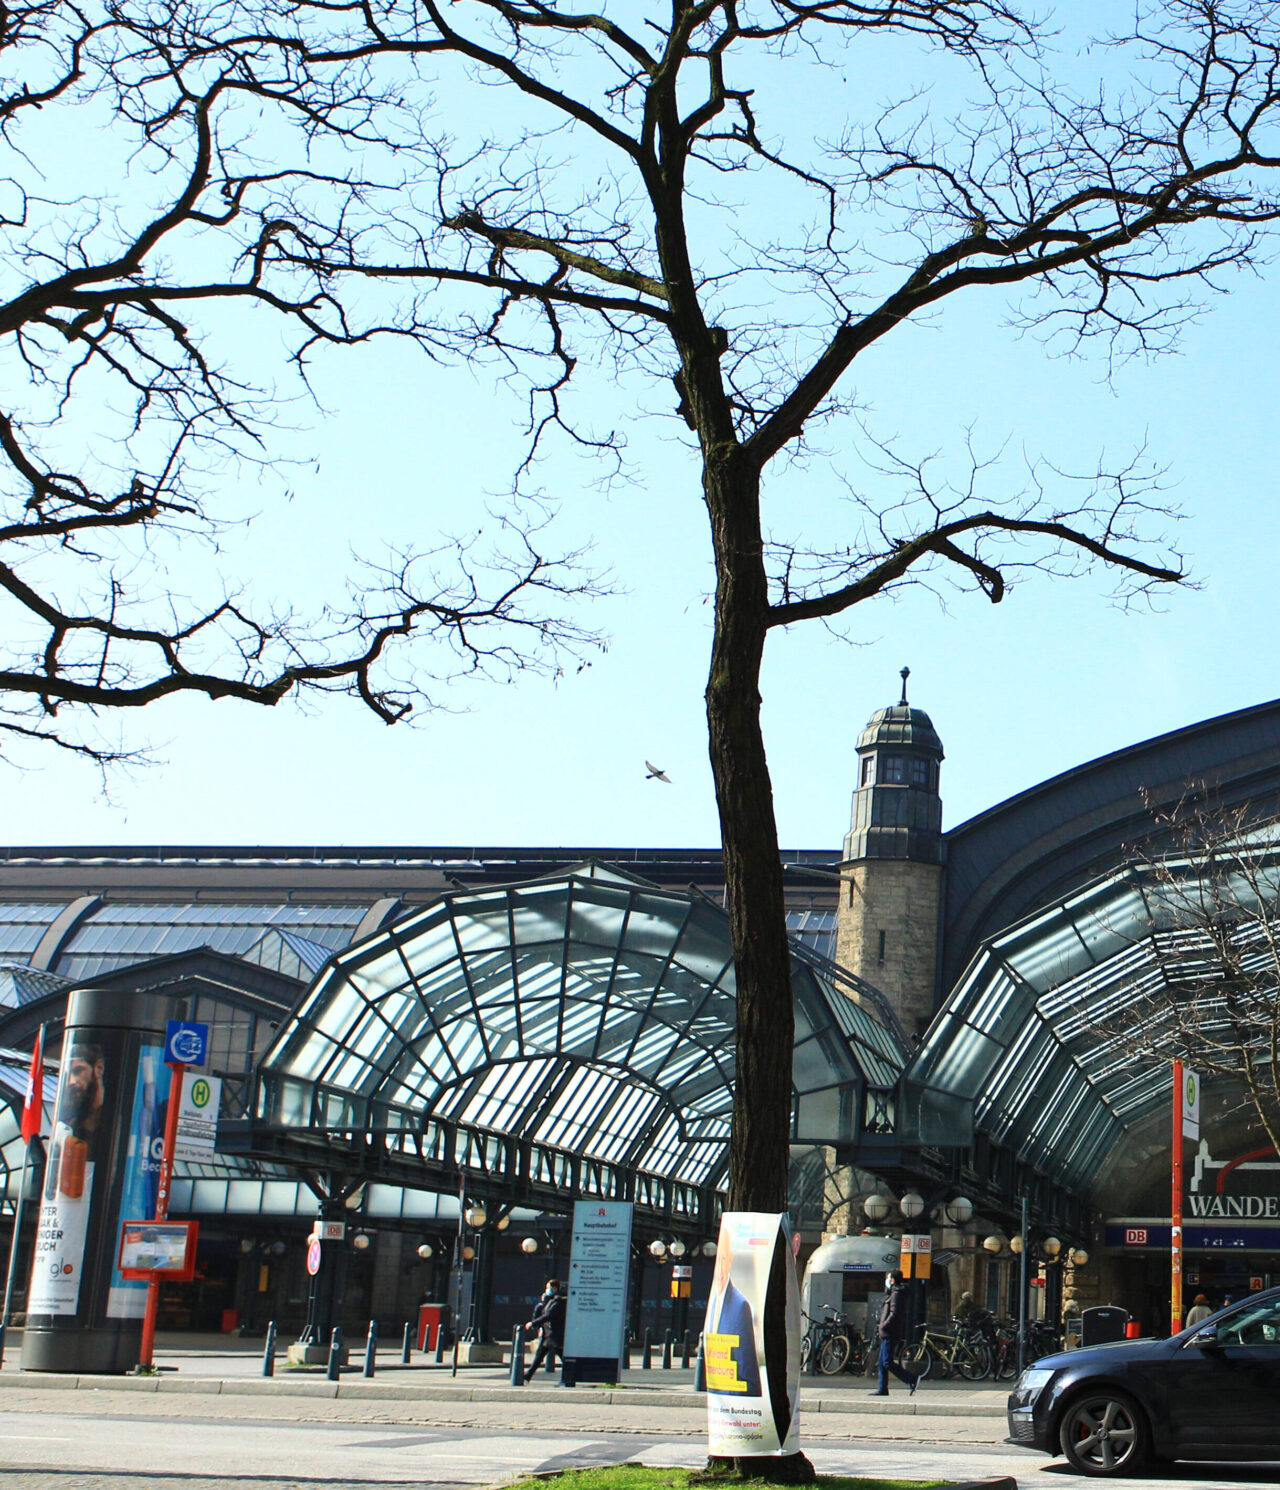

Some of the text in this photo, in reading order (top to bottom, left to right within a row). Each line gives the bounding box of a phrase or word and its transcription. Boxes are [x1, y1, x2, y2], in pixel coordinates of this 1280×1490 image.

[195, 1084, 206, 1102] H
[1128, 1230, 1146, 1242] DB
[50, 1256, 74, 1278] glo
[730, 1407, 762, 1417] Bundestag
